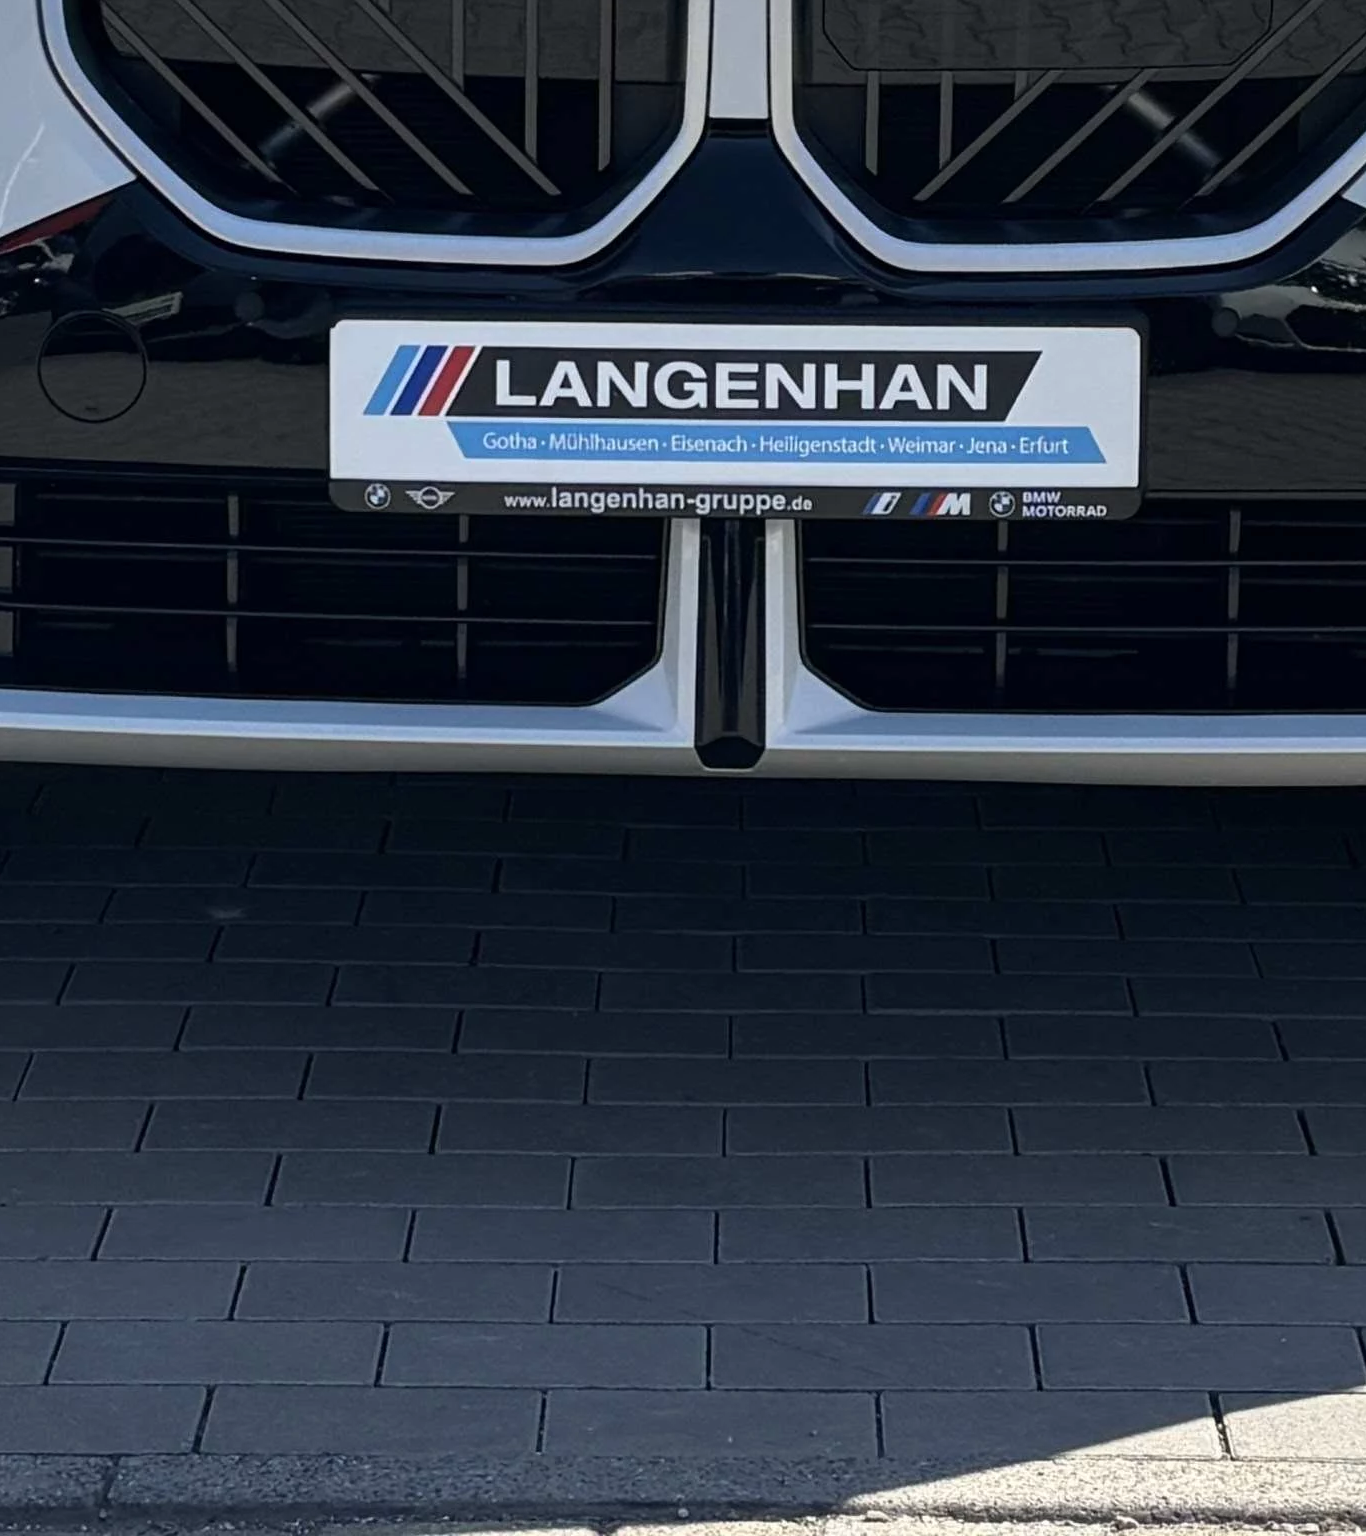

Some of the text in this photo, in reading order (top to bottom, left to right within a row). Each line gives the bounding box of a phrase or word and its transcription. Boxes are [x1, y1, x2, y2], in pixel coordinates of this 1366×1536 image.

[496, 360, 988, 410] LANGENHAN
[482, 432, 1069, 457] Gotha Mühlhausen Eisenach Heiligenstadt Weimar Jena Erfurt
[503, 487, 813, 515] www.langenhan-gruppe.de
[1022, 491, 1062, 504] BMW
[1022, 504, 1107, 518] MOTORRAD
